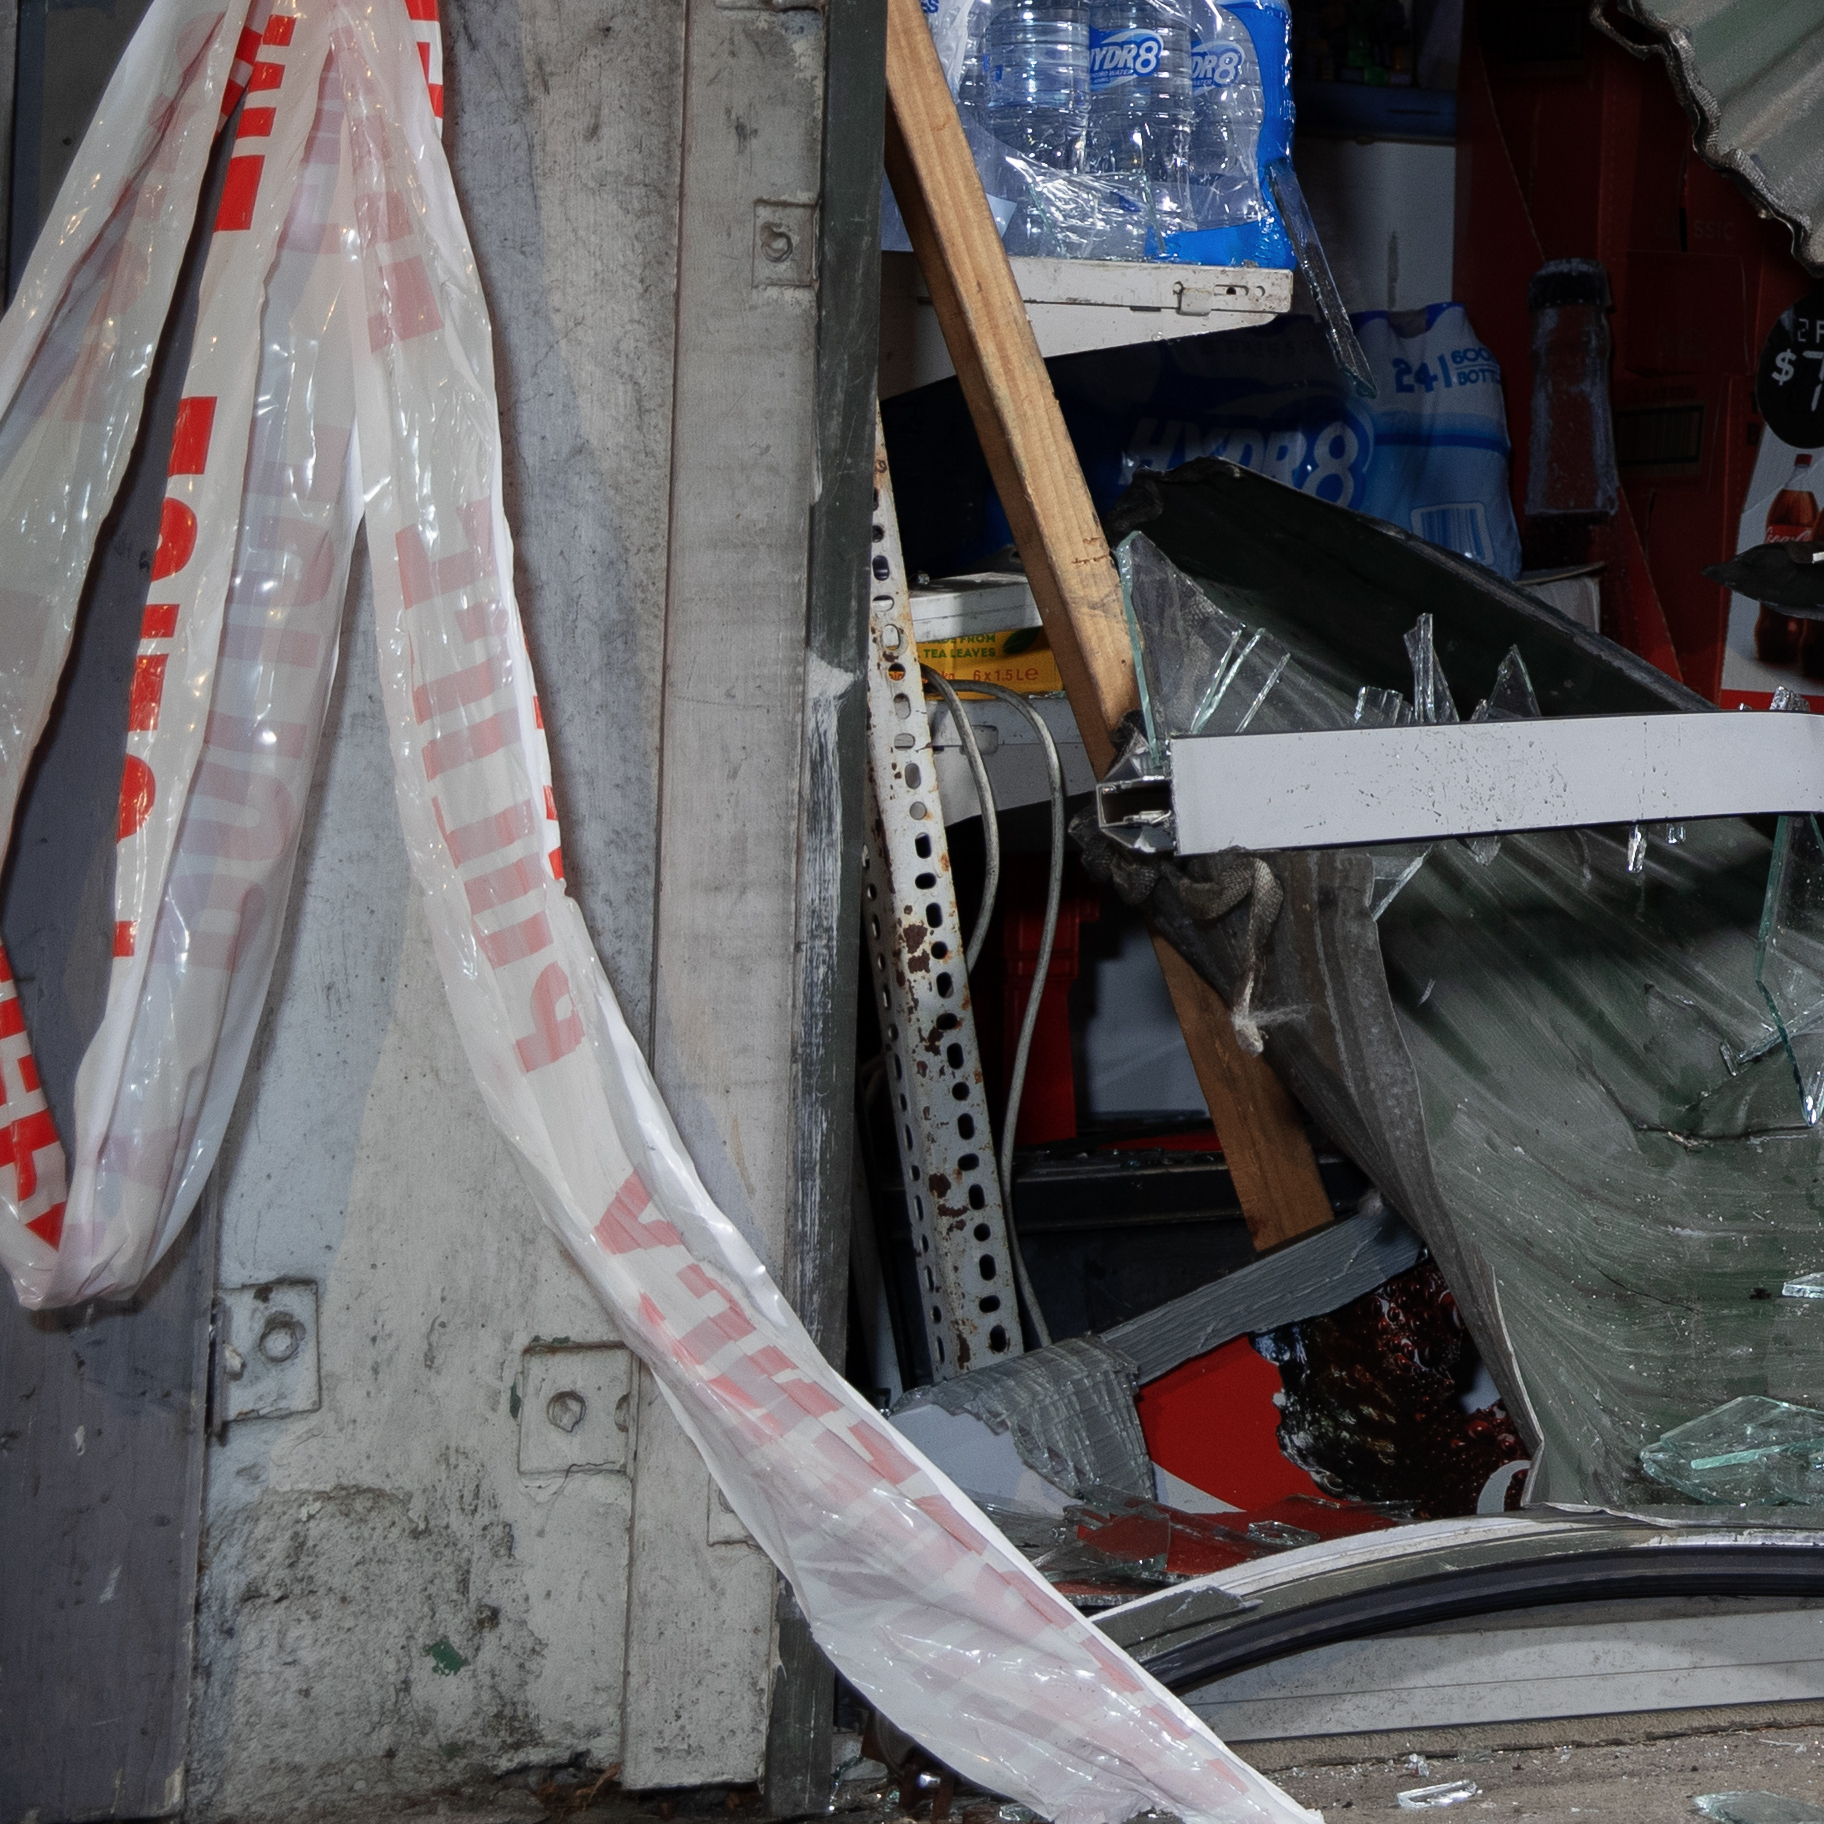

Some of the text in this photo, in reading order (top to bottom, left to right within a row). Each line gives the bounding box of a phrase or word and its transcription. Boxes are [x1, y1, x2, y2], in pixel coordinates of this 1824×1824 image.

[1796, 318, 1810, 343] 2
[1391, 357, 1440, 393] 24
[923, 648, 996, 659] TEA LEAVES
